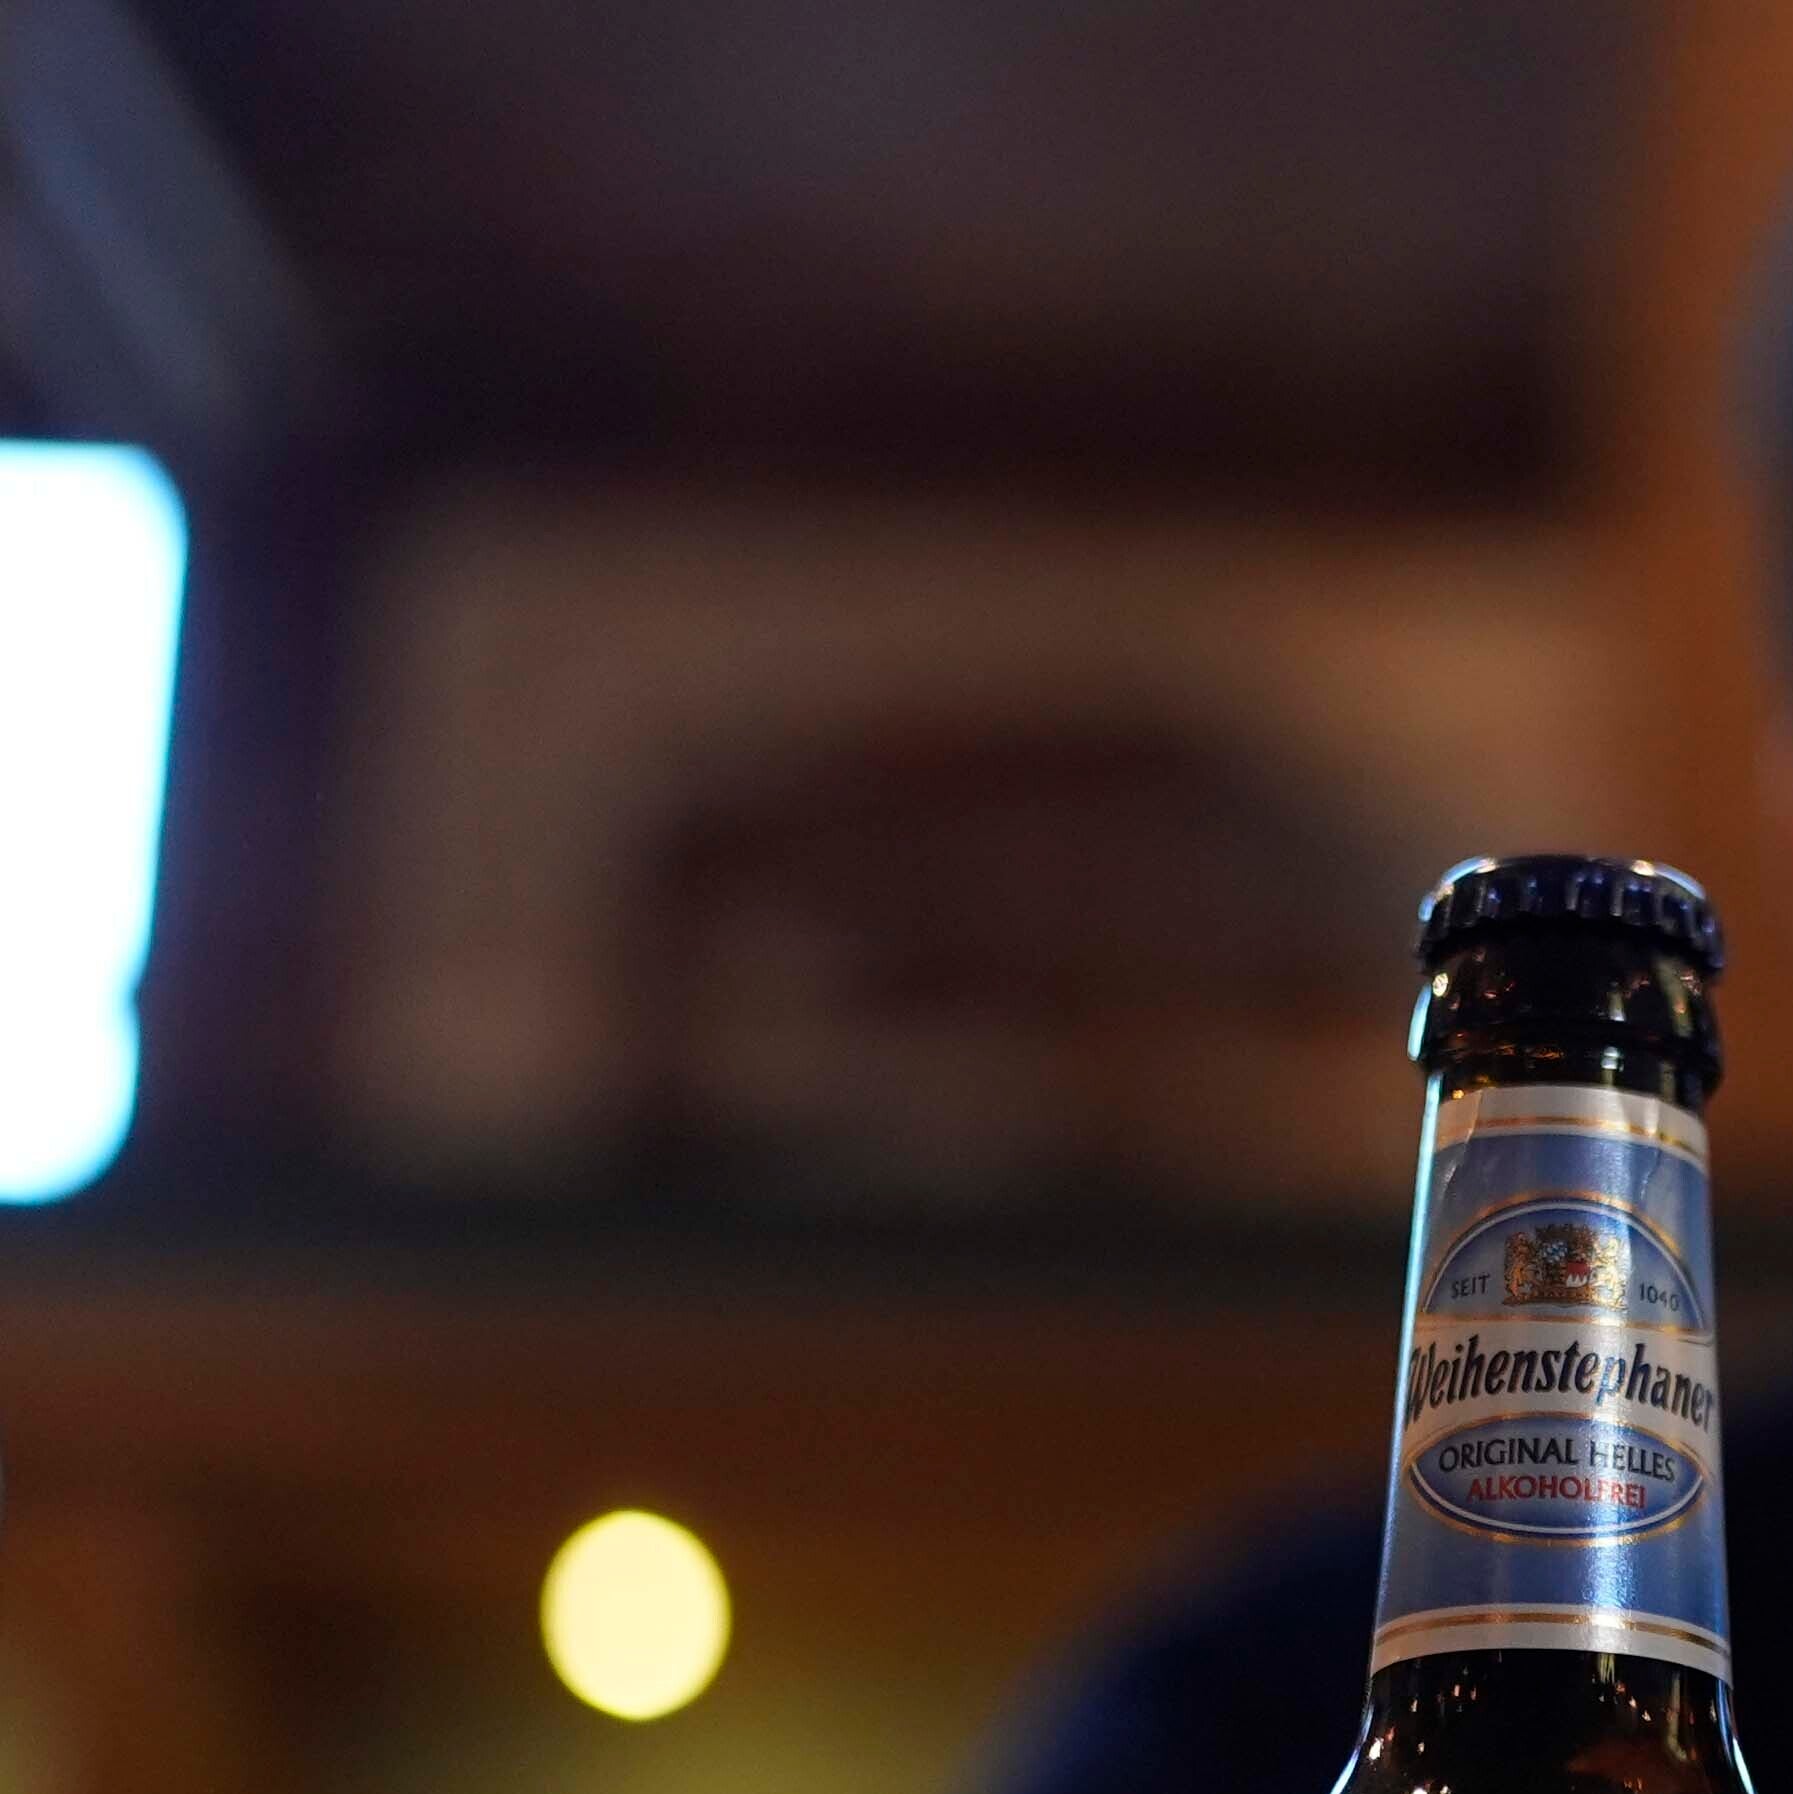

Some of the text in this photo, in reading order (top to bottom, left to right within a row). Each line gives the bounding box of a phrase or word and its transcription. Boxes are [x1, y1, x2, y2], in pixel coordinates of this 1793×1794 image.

[1450, 1272, 1682, 1313] SEIT 1040
[1438, 1437, 1676, 1482] ORIGINAL HELLES
[1466, 1475, 1647, 1509] ALKOHOLFREI
